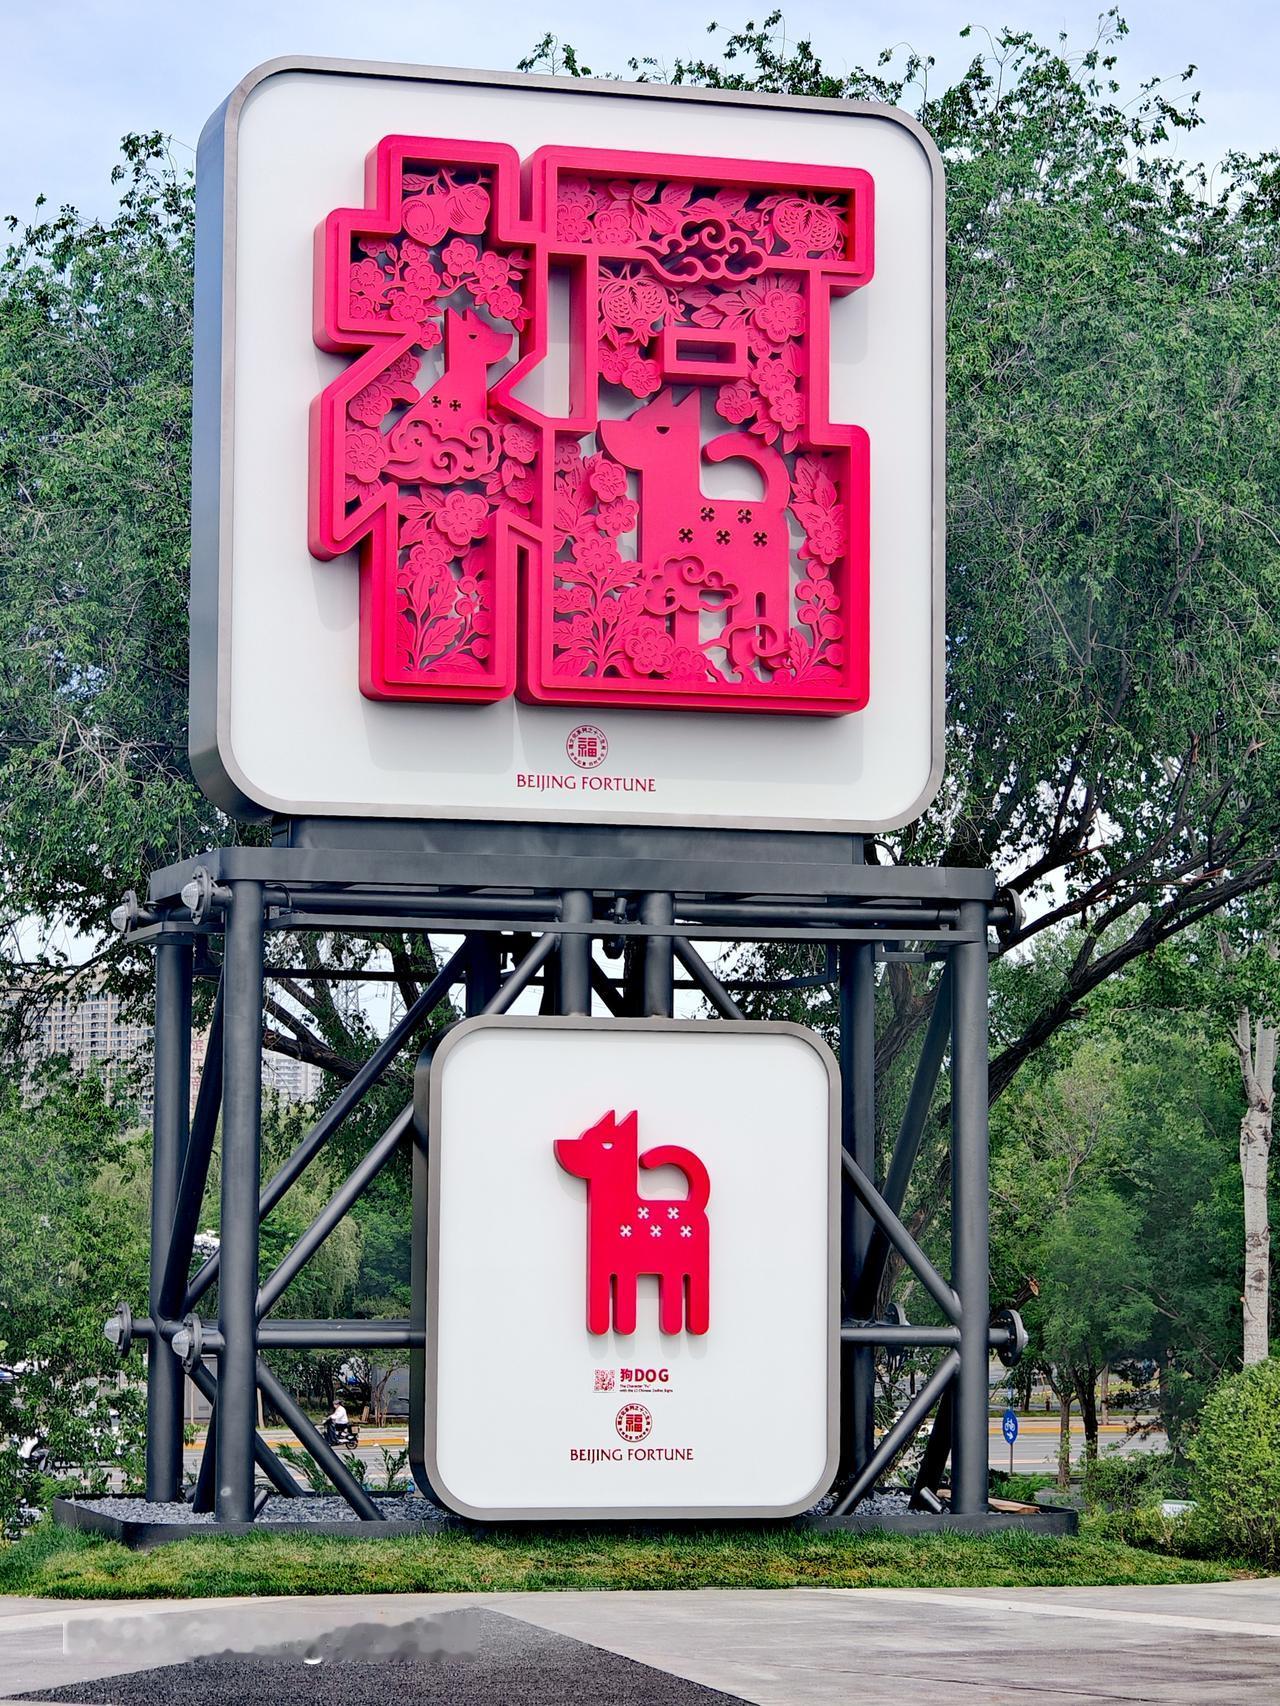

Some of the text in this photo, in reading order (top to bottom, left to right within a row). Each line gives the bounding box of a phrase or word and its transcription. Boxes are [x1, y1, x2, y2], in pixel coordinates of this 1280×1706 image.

[577, 737, 597, 757] 福
[516, 774, 657, 792] BEIJING FORTUNE
[625, 1413, 643, 1433] 福
[570, 1448, 694, 1464] BEIJING FORTUNE
